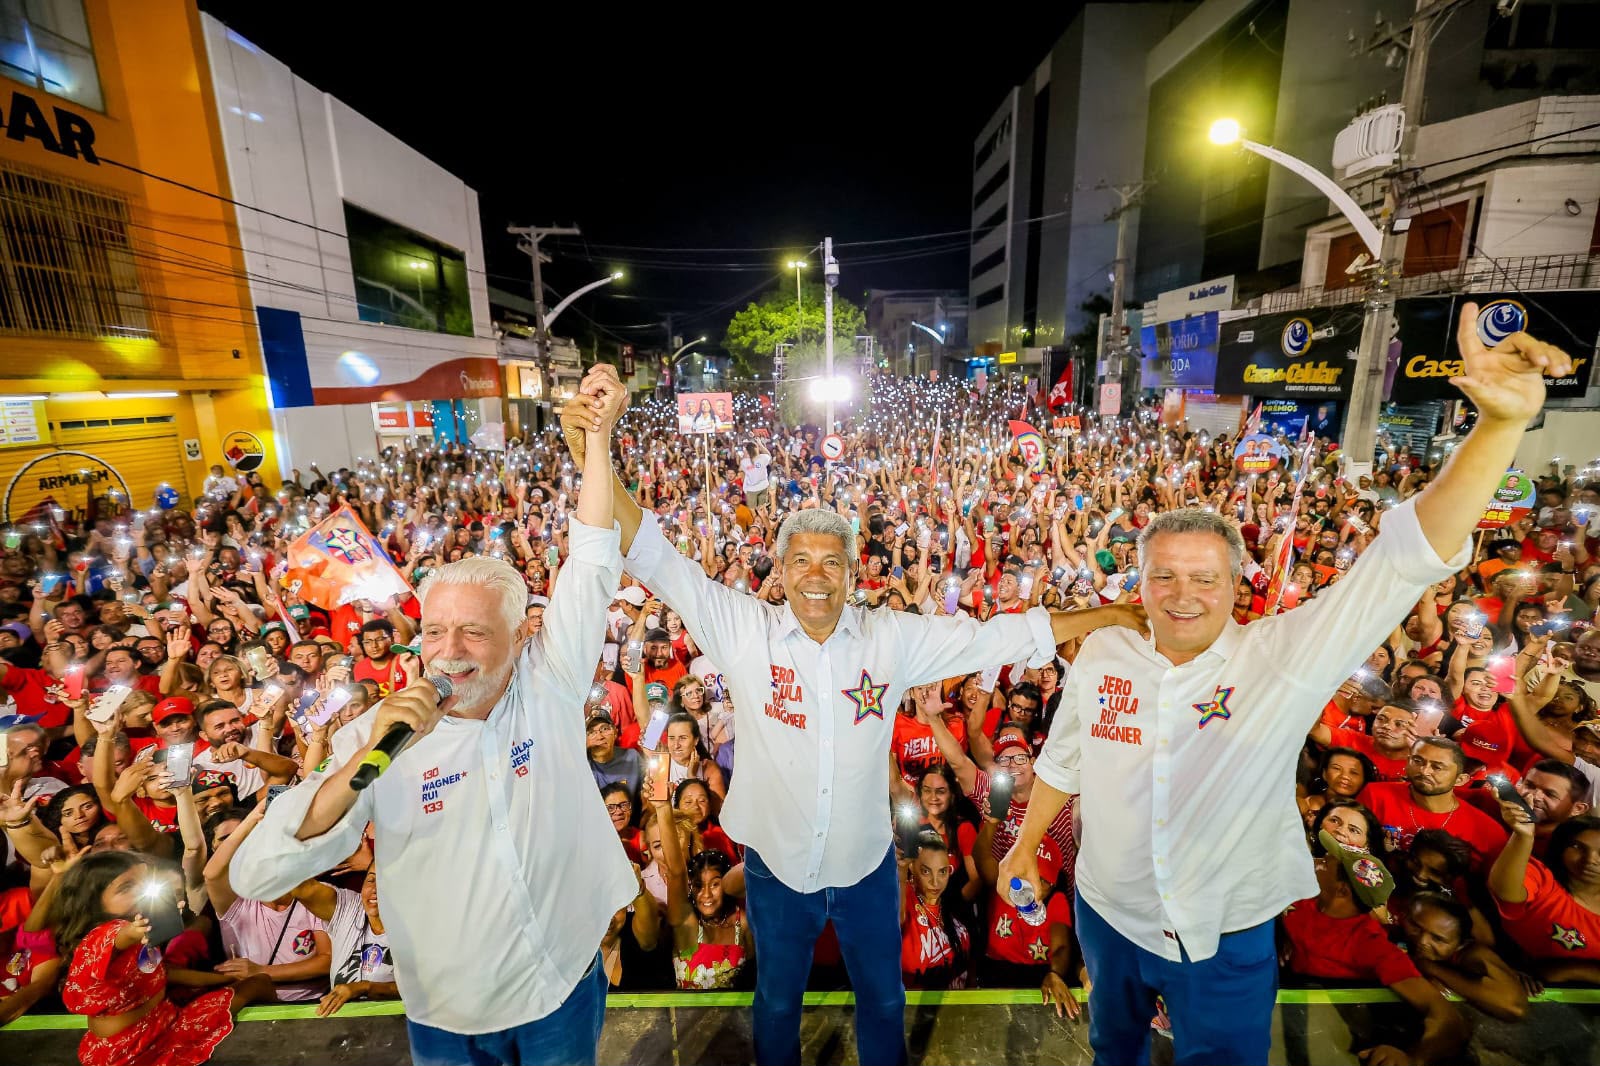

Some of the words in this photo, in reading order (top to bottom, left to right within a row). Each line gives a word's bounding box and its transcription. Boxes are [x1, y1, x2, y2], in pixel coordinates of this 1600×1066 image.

[0, 91, 100, 166] AR
[1405, 354, 1465, 378] Casa
[1556, 378, 1578, 386] SERÁ
[1098, 675, 1132, 697] JERO
[860, 689, 876, 708] 13
[1108, 695, 1139, 715] LULA
[764, 702, 807, 730] WAGNER
[1100, 708, 1118, 725] RUI
[1090, 723, 1142, 746] WAGNER
[422, 767, 440, 781] 130
[515, 765, 529, 778] 13
[422, 773, 461, 793] WAGNER
[422, 790, 439, 803] RUI
[423, 800, 445, 815] 133
